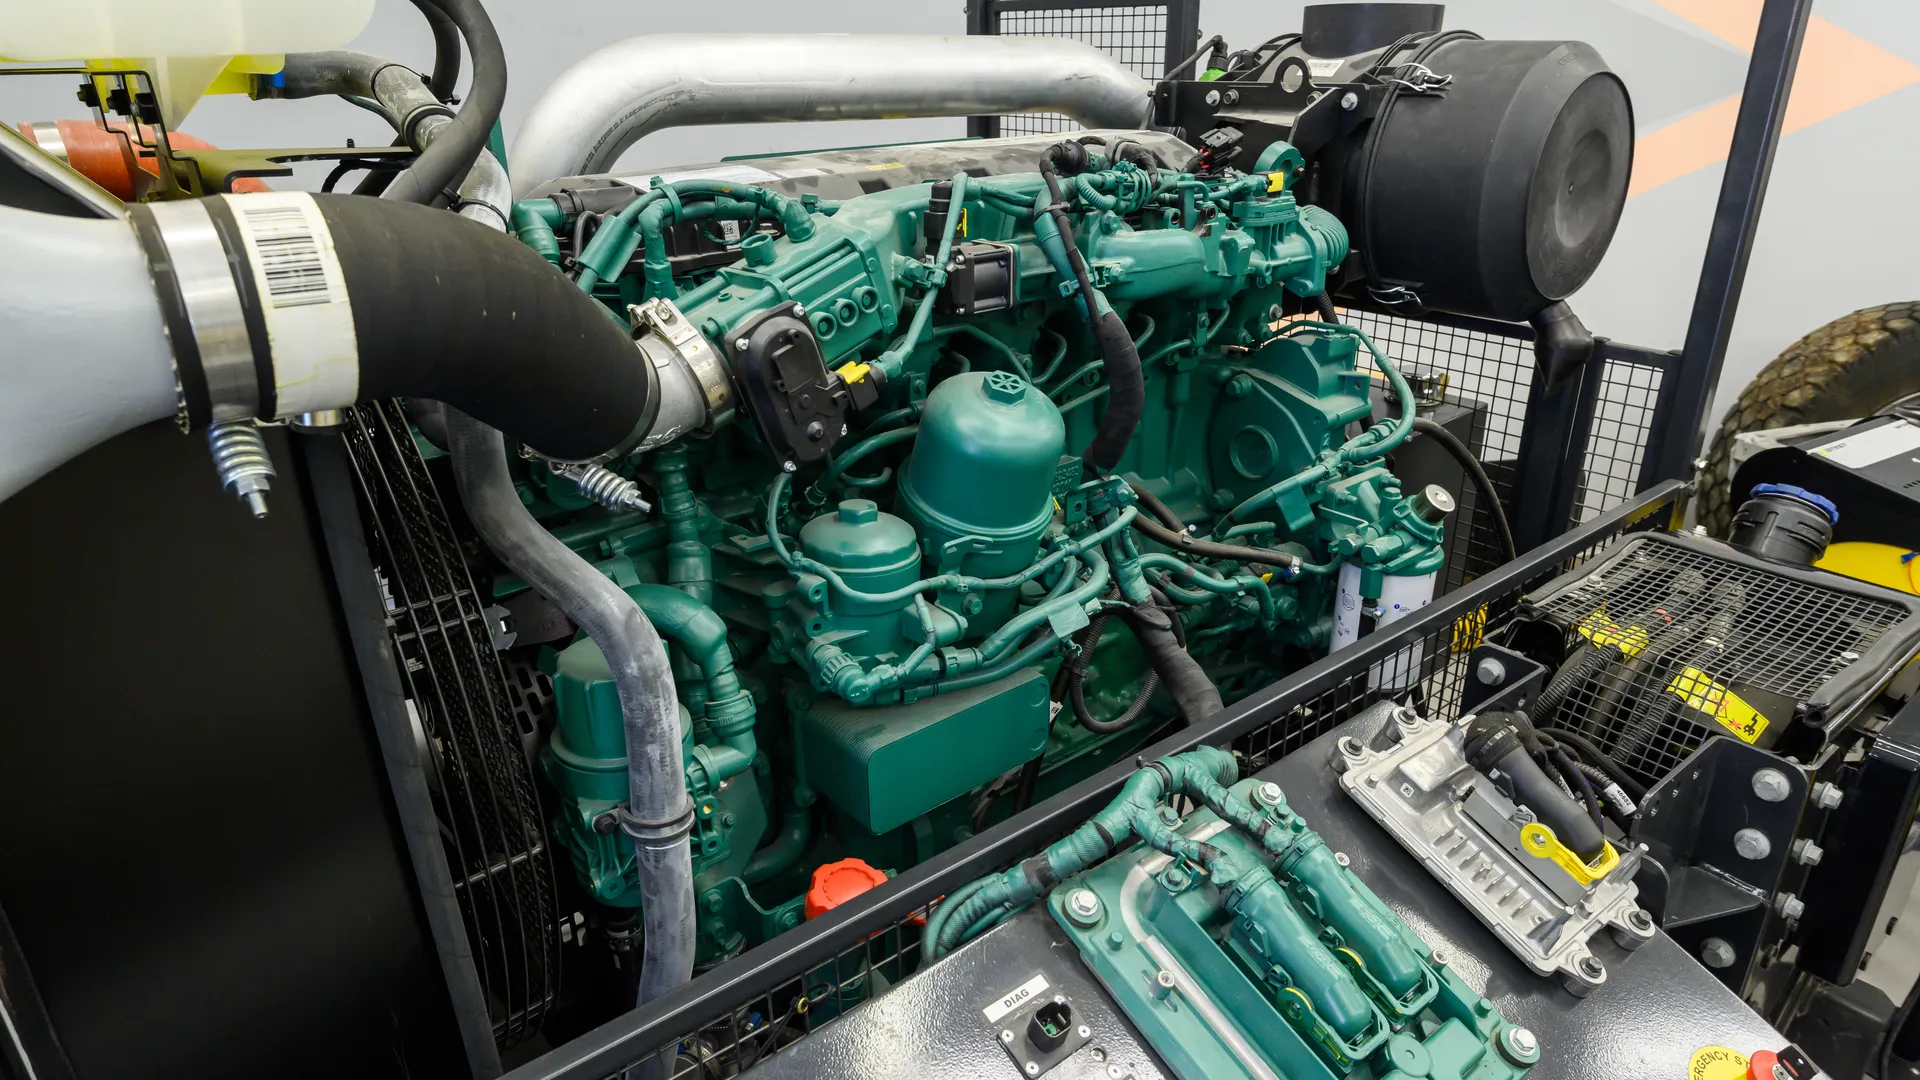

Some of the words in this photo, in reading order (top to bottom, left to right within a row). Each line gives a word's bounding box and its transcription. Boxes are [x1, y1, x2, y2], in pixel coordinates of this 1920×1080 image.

[1003, 988, 1030, 1008] DIAG
[1693, 1050, 1729, 1080] ERGENCY
[1734, 1055, 1750, 1068] ST
